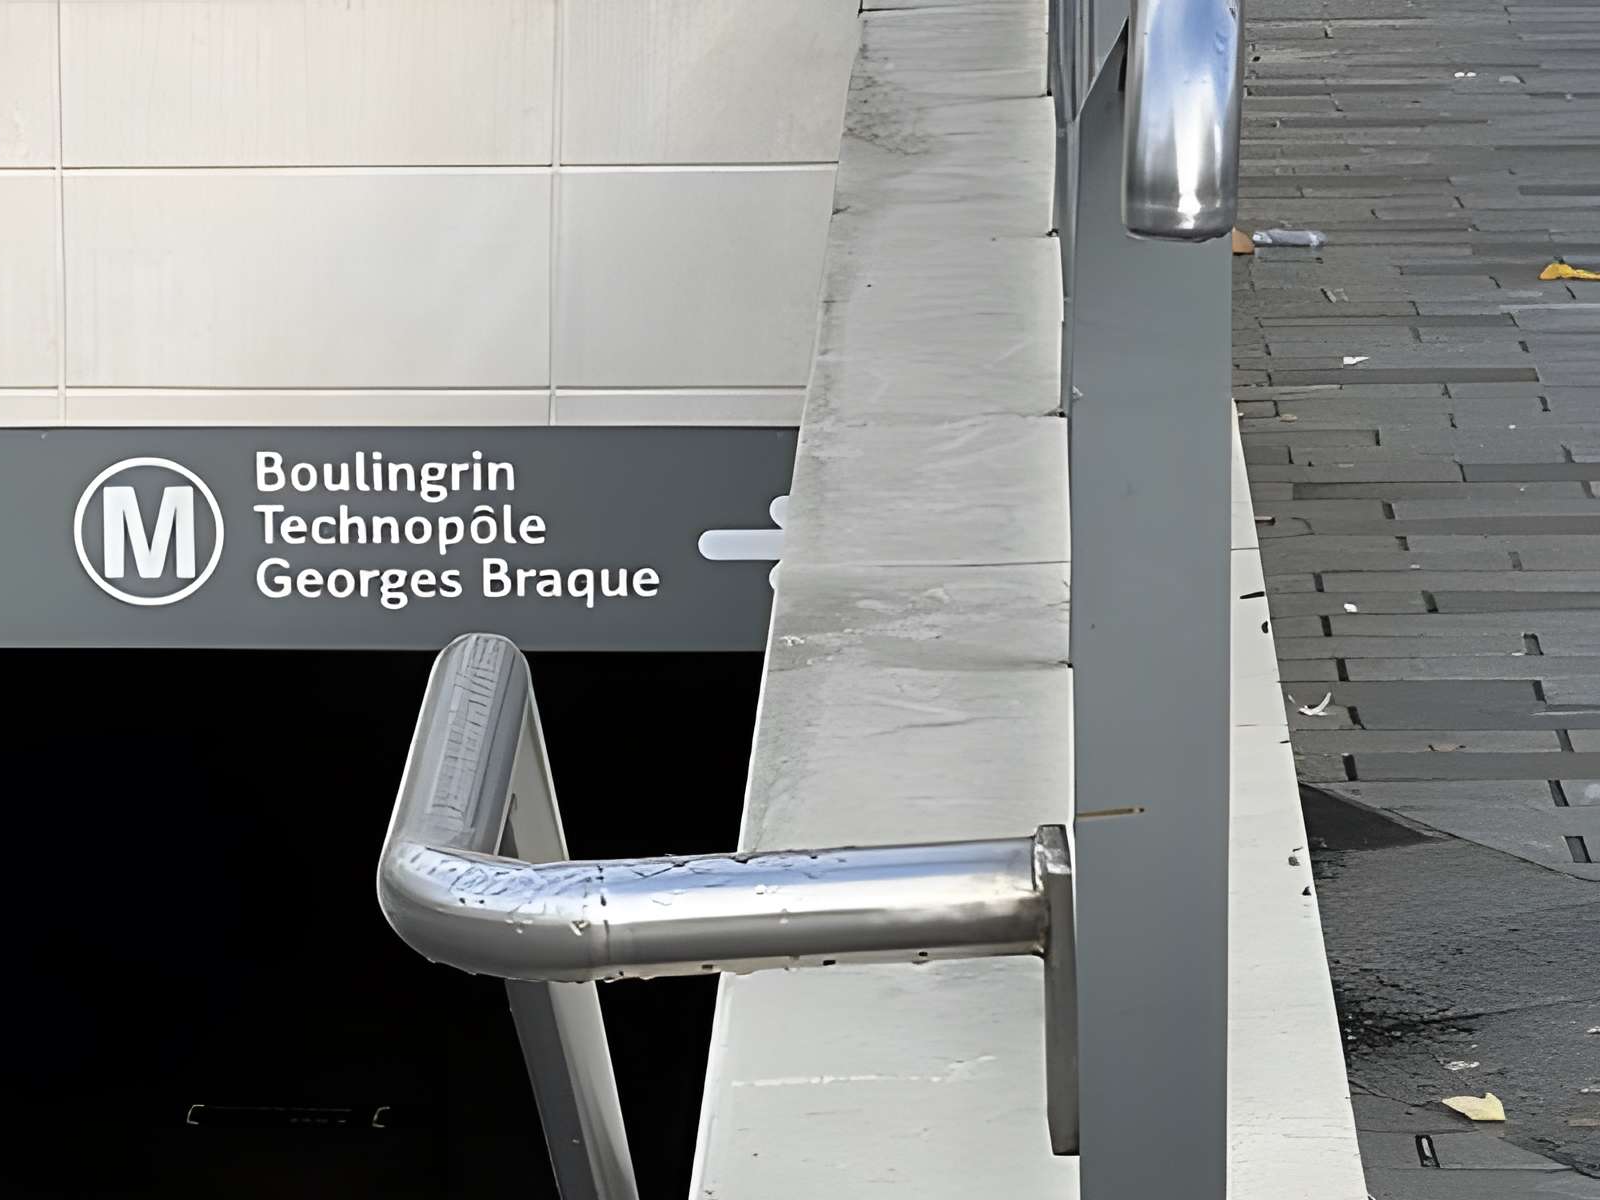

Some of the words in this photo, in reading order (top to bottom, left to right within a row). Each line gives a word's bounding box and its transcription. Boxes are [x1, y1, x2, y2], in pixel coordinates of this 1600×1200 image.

[255, 450, 515, 504] Boulingrin
[102, 485, 196, 579] M
[252, 504, 547, 556] Technopôle
[256, 557, 463, 610] Georges
[482, 557, 660, 609] Braque
